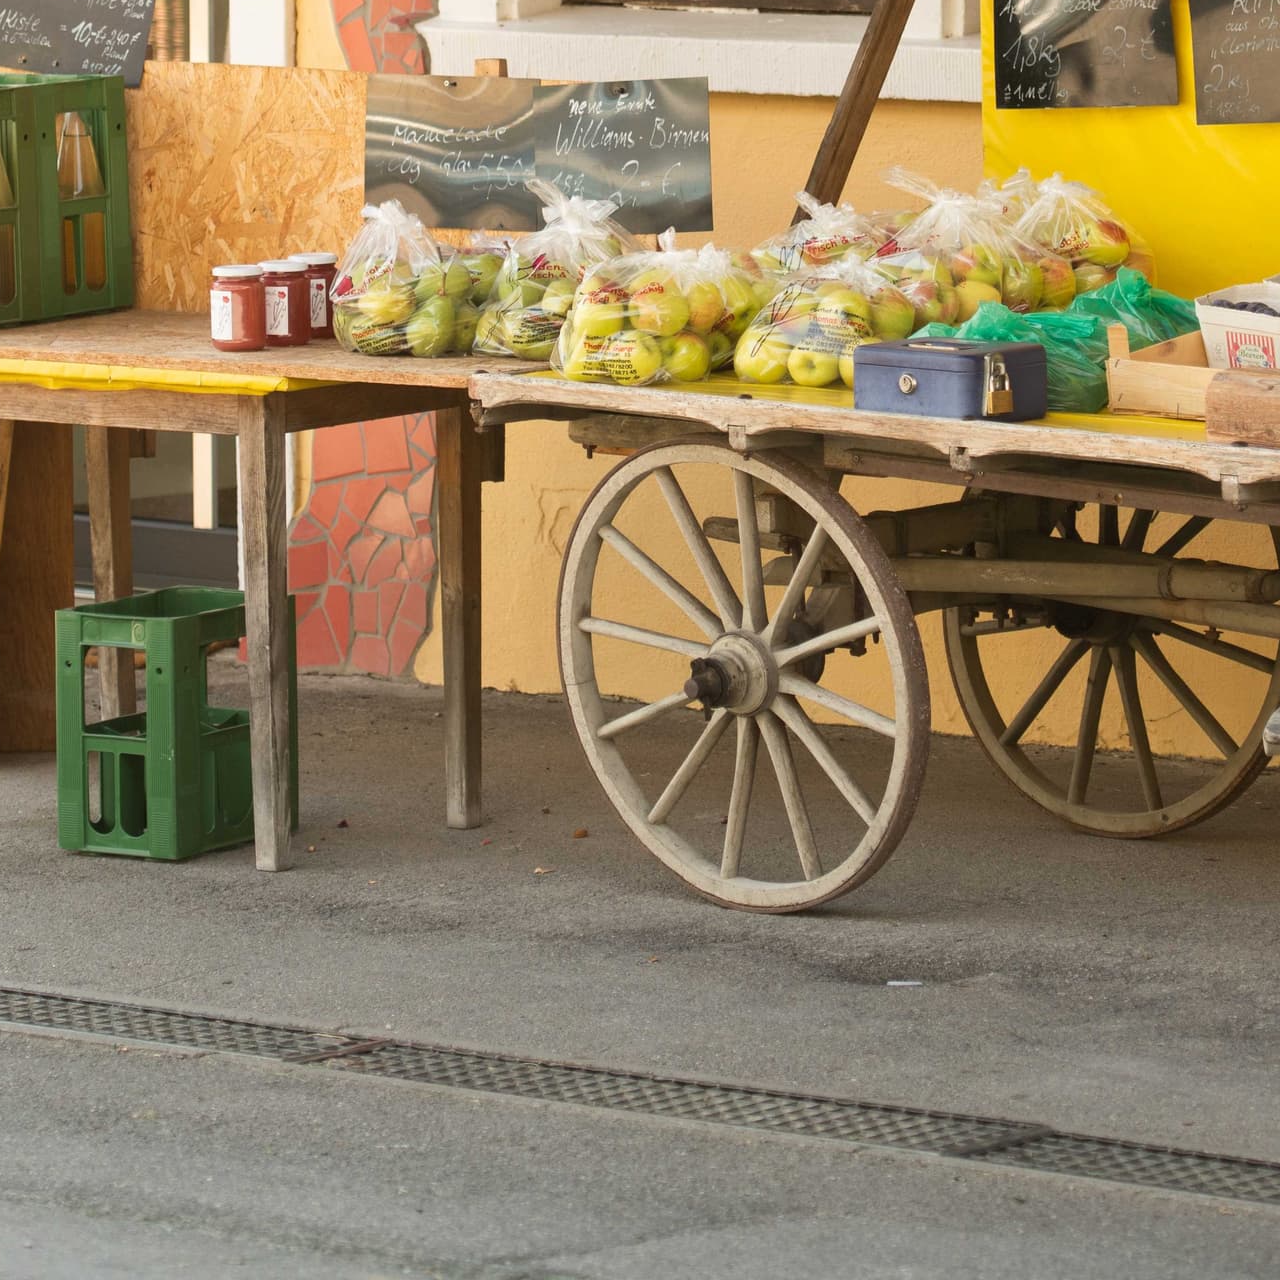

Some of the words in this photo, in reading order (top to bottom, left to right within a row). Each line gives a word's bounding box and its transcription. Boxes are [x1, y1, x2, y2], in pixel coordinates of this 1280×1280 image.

[1225, 19, 1248, 32] aus
[568, 97, 604, 119] neue
[391, 124, 508, 146] Marmelade
